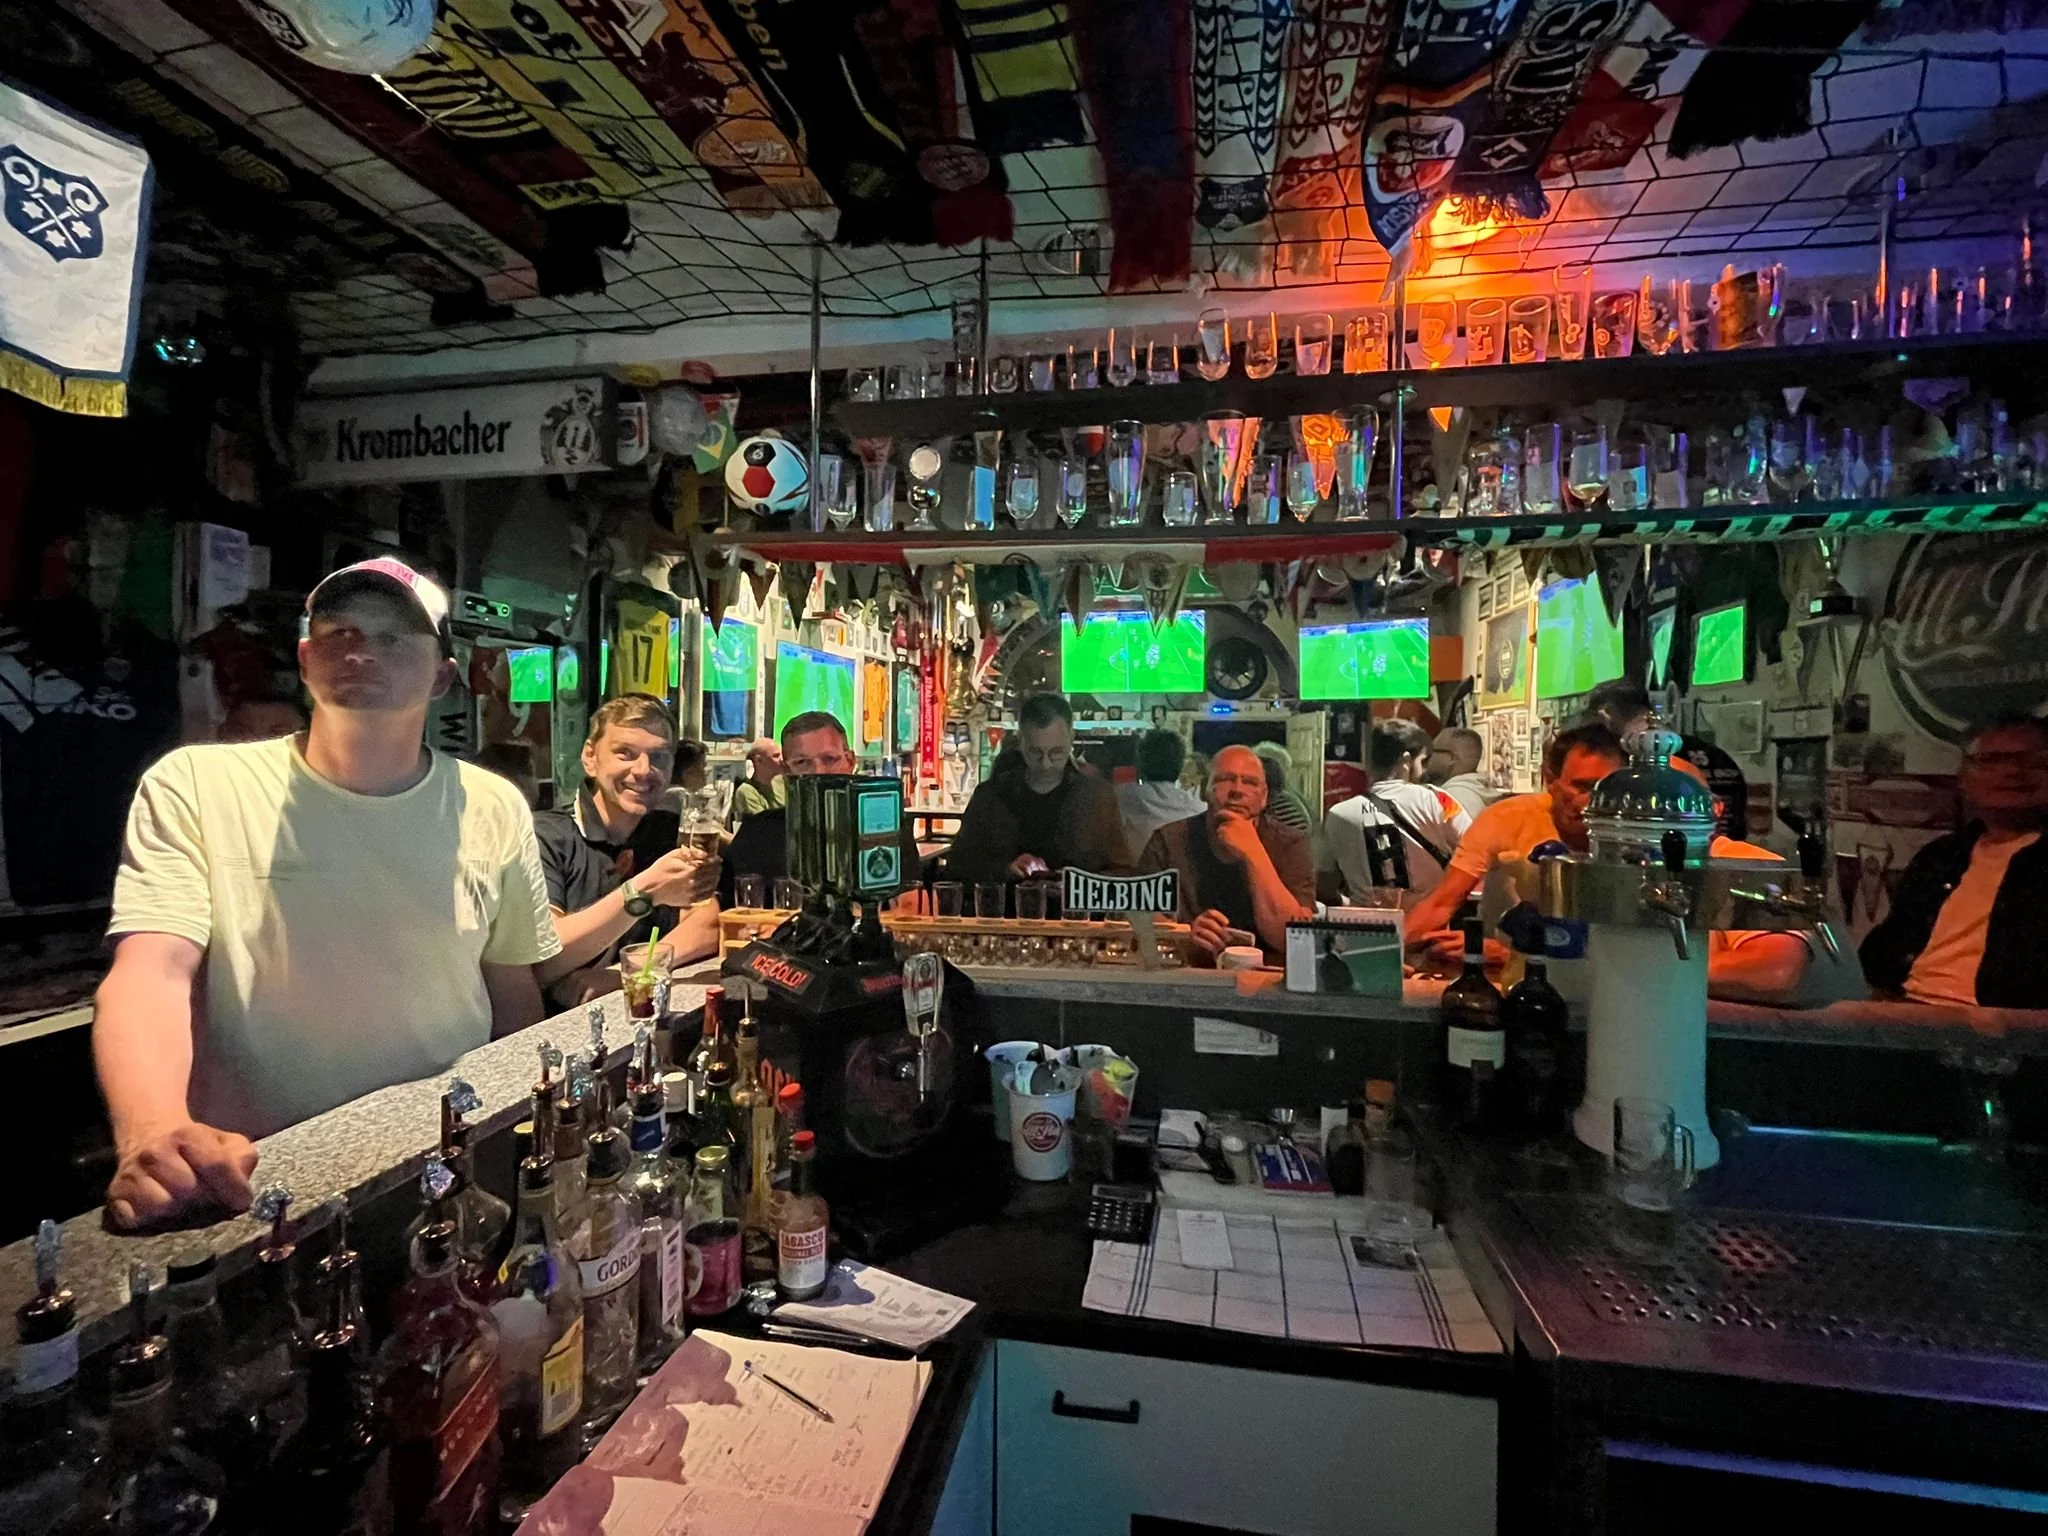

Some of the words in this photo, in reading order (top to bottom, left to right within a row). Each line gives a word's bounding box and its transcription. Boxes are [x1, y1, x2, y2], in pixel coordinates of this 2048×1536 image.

[335, 410, 511, 463] Krombacher
[632, 634, 653, 683] 17
[1069, 870, 1172, 911] HELBING
[751, 952, 771, 976] ICE
[769, 960, 807, 990] COLD!
